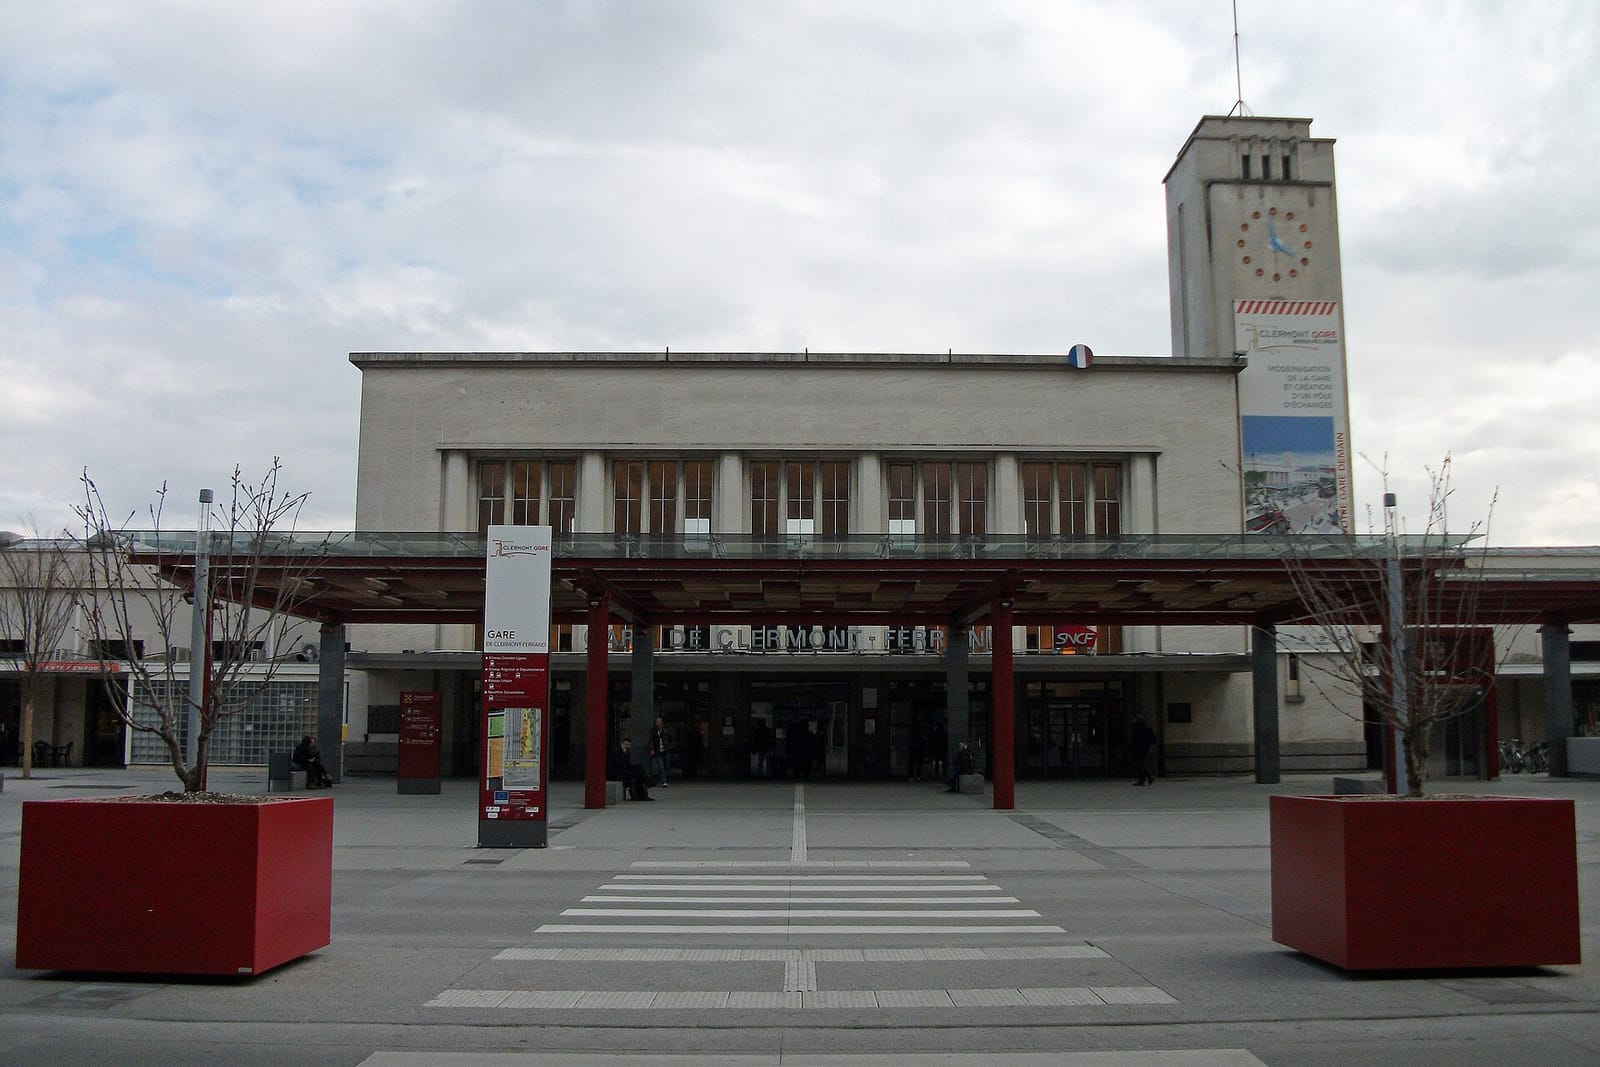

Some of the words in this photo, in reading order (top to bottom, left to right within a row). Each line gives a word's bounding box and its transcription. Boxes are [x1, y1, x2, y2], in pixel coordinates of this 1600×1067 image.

[487, 630, 515, 639] GARE
[669, 629, 702, 648] DE
[717, 629, 863, 649] CLERMONT
[1056, 632, 1096, 645] SNCF
